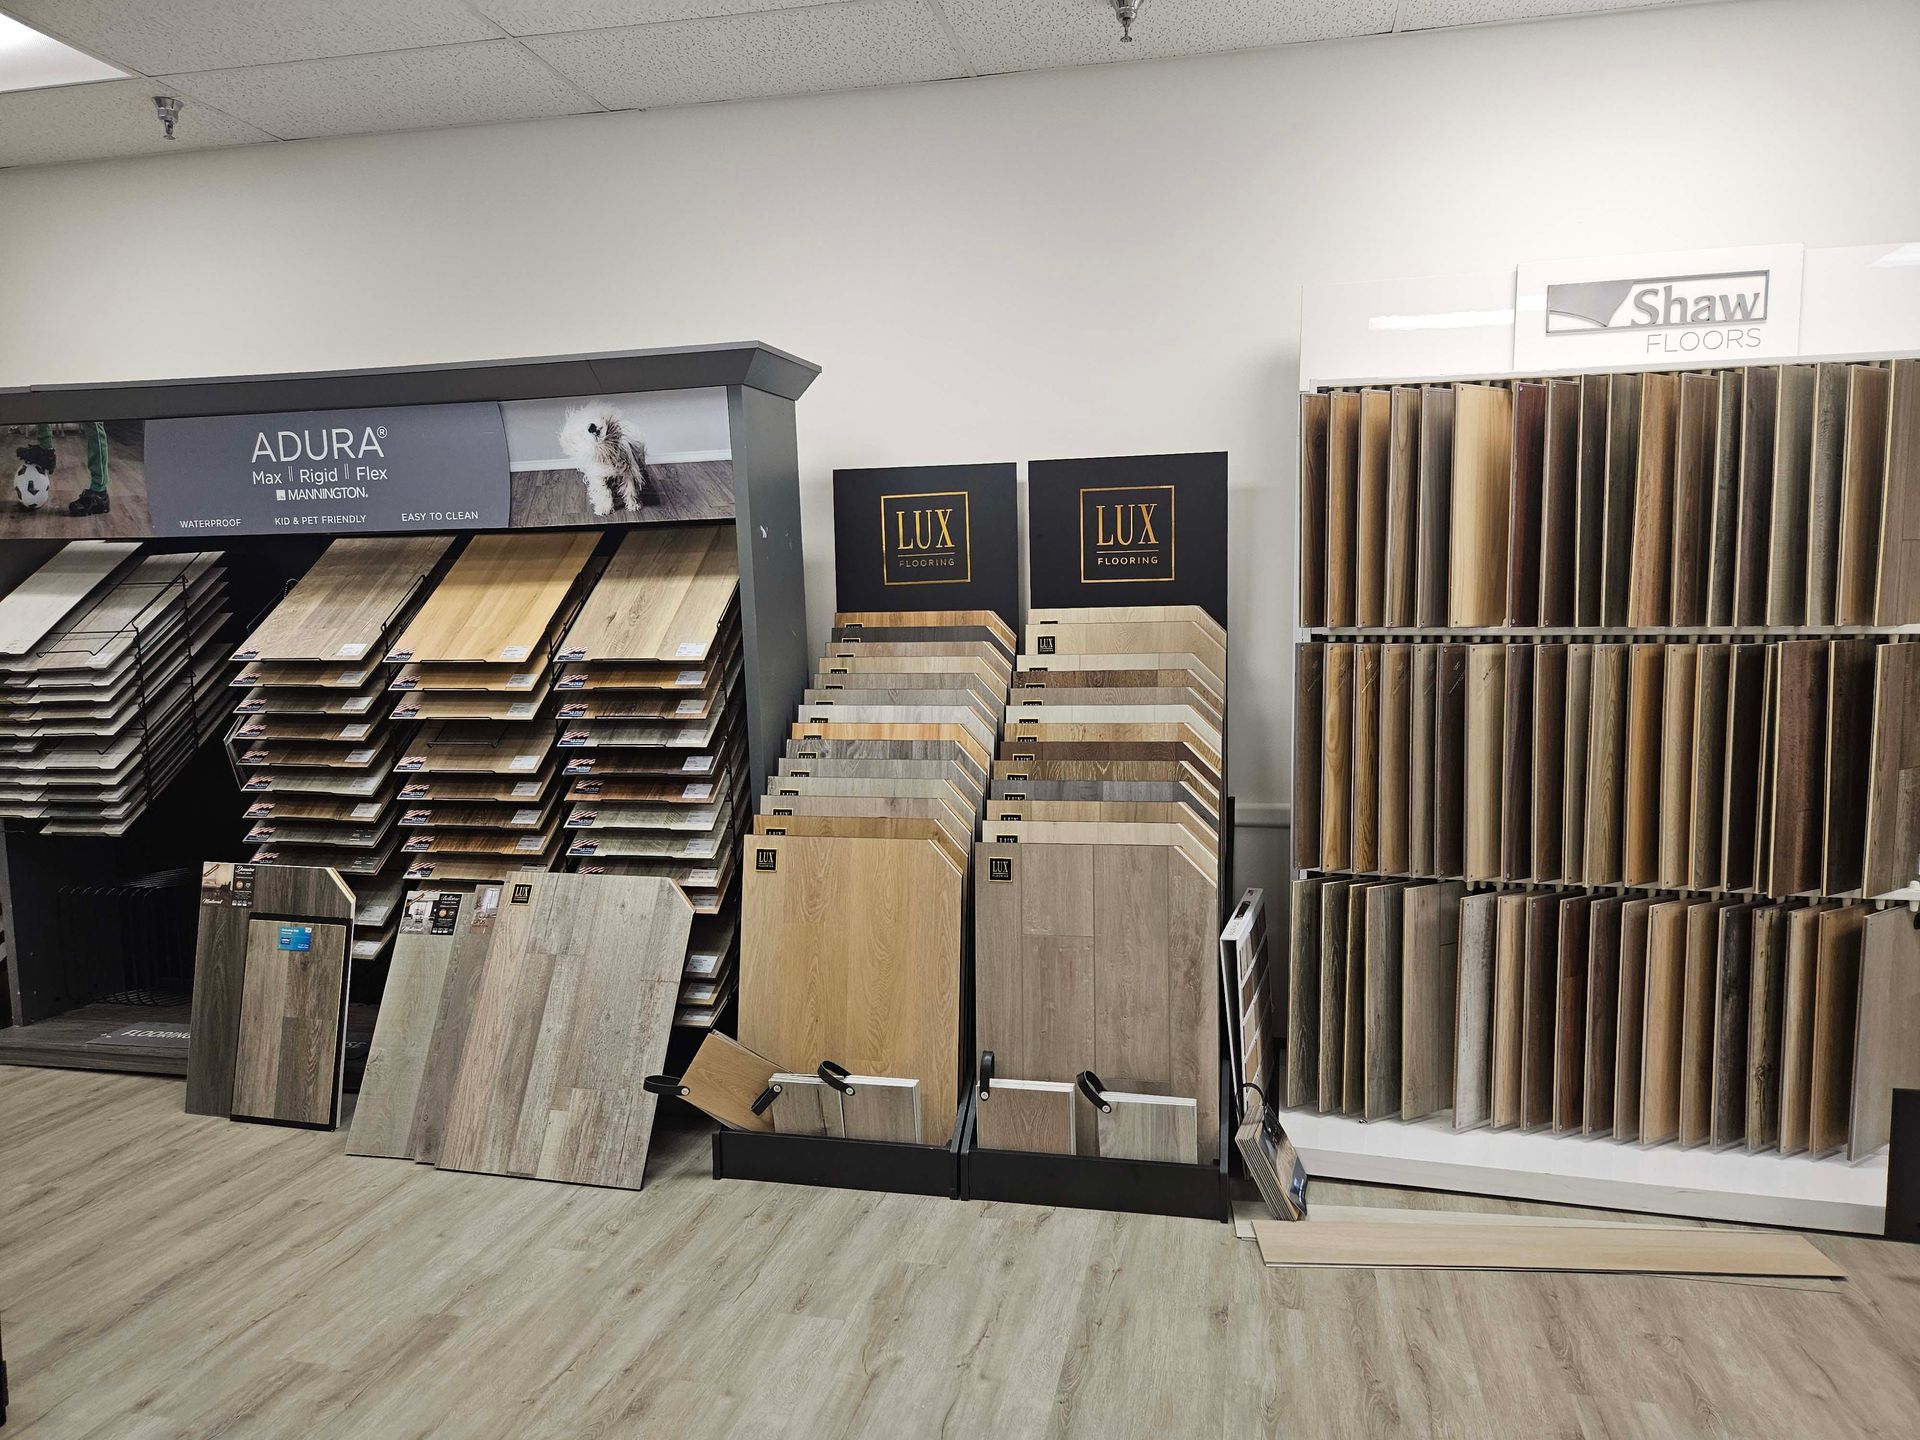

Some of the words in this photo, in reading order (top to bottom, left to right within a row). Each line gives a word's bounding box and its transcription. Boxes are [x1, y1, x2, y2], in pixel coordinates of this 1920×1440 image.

[1630, 284, 1761, 327] Shaw
[1646, 328, 1762, 353] FLOORS
[252, 471, 283, 485] Max
[299, 468, 338, 485] Rigid
[356, 466, 388, 481] Flex
[274, 516, 291, 526] KID
[292, 516, 300, 525] &
[301, 515, 319, 525] PET
[321, 514, 367, 524] FRIENDLY
[401, 512, 427, 522] EASY
[429, 512, 443, 521] TO
[445, 511, 479, 520] CLEAN
[179, 519, 242, 528] WATERPROOF
[896, 508, 955, 550] LUX
[1096, 503, 1159, 546] LUX
[898, 558, 956, 567] FLOORING
[1097, 556, 1159, 565] FLOORING
[1039, 638, 1053, 649] LUX
[758, 851, 774, 863] LUX
[992, 860, 1008, 873] LUX
[514, 885, 530, 897] LUX
